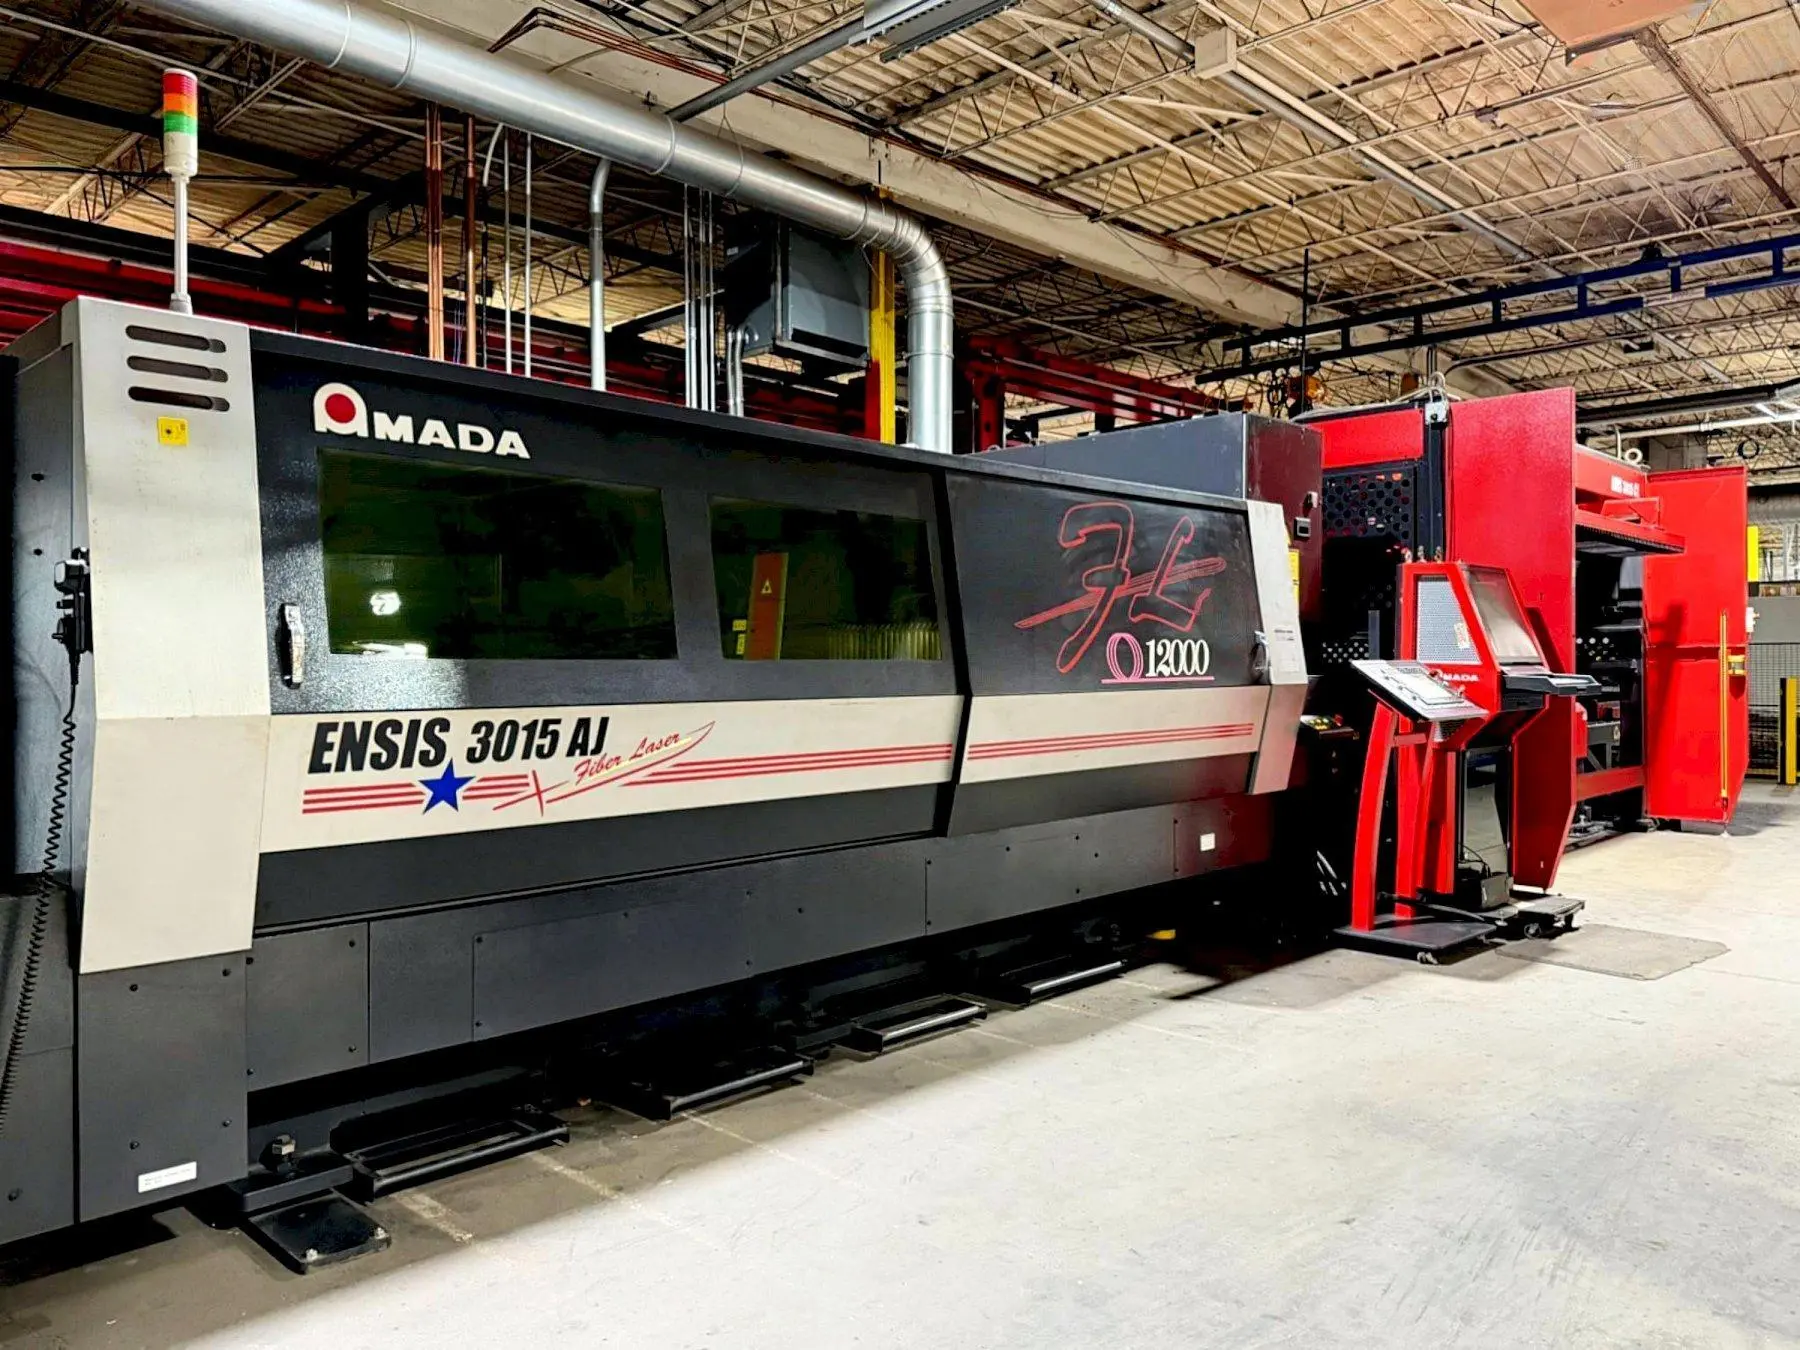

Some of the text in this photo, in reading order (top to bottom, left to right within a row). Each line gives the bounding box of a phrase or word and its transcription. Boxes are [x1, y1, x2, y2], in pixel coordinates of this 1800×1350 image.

[313, 382, 531, 459] AMADA
[1145, 638, 1210, 678] 12000
[307, 716, 610, 774] ENSIS 3015 AJ
[574, 733, 680, 785] Fiber Laser
